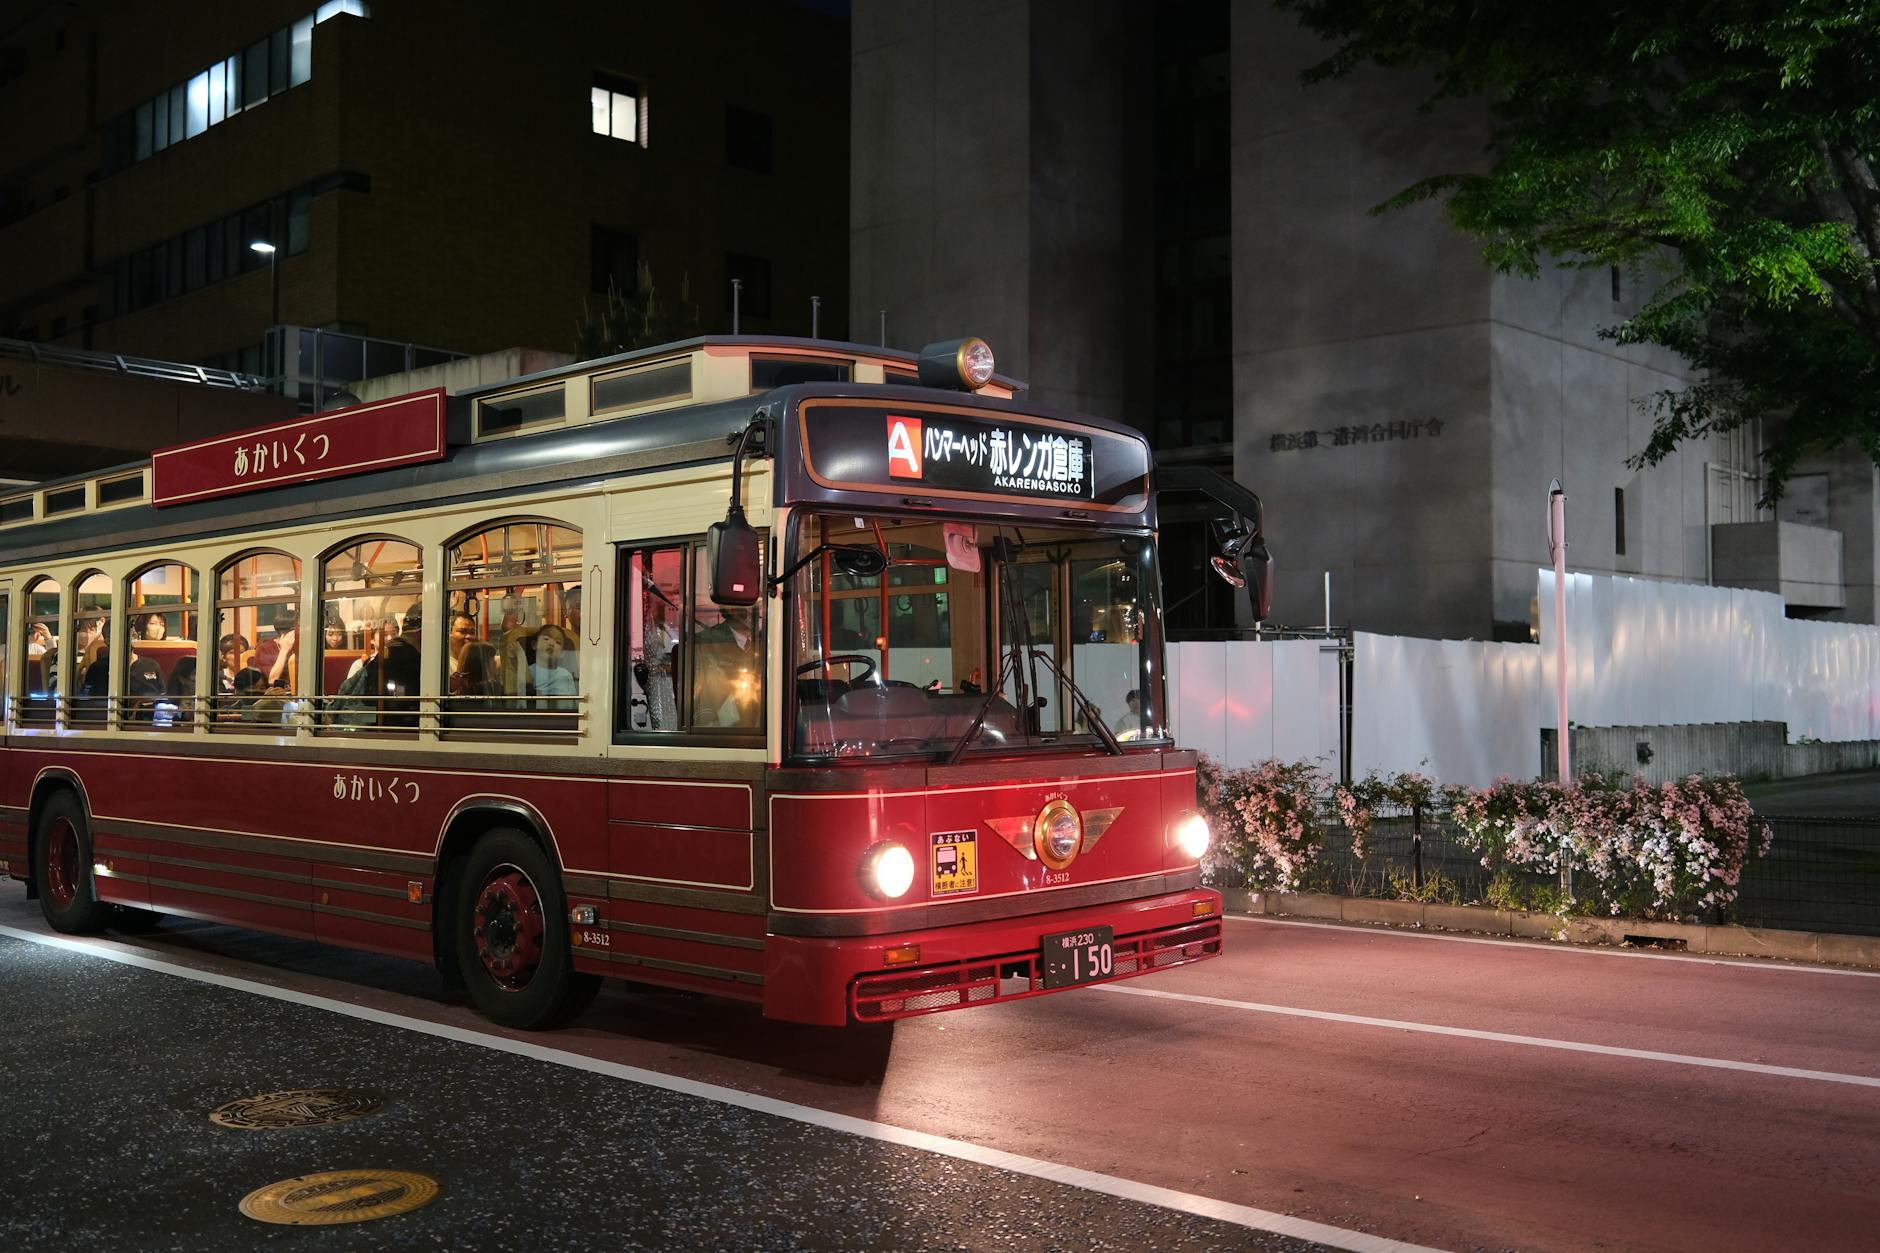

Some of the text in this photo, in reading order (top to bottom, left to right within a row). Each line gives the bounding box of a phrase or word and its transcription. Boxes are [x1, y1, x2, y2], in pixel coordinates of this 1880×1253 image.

[234, 432, 330, 477] あかいくつ
[887, 421, 919, 473] A
[923, 426, 1084, 483] ハンマーヘッド 赤レンガ倉庫
[993, 475, 1082, 495] AKARENGASOKO
[333, 773, 420, 804] あかいくつ
[1046, 872, 1070, 885] 8-3512
[584, 930, 610, 946] 8-3512
